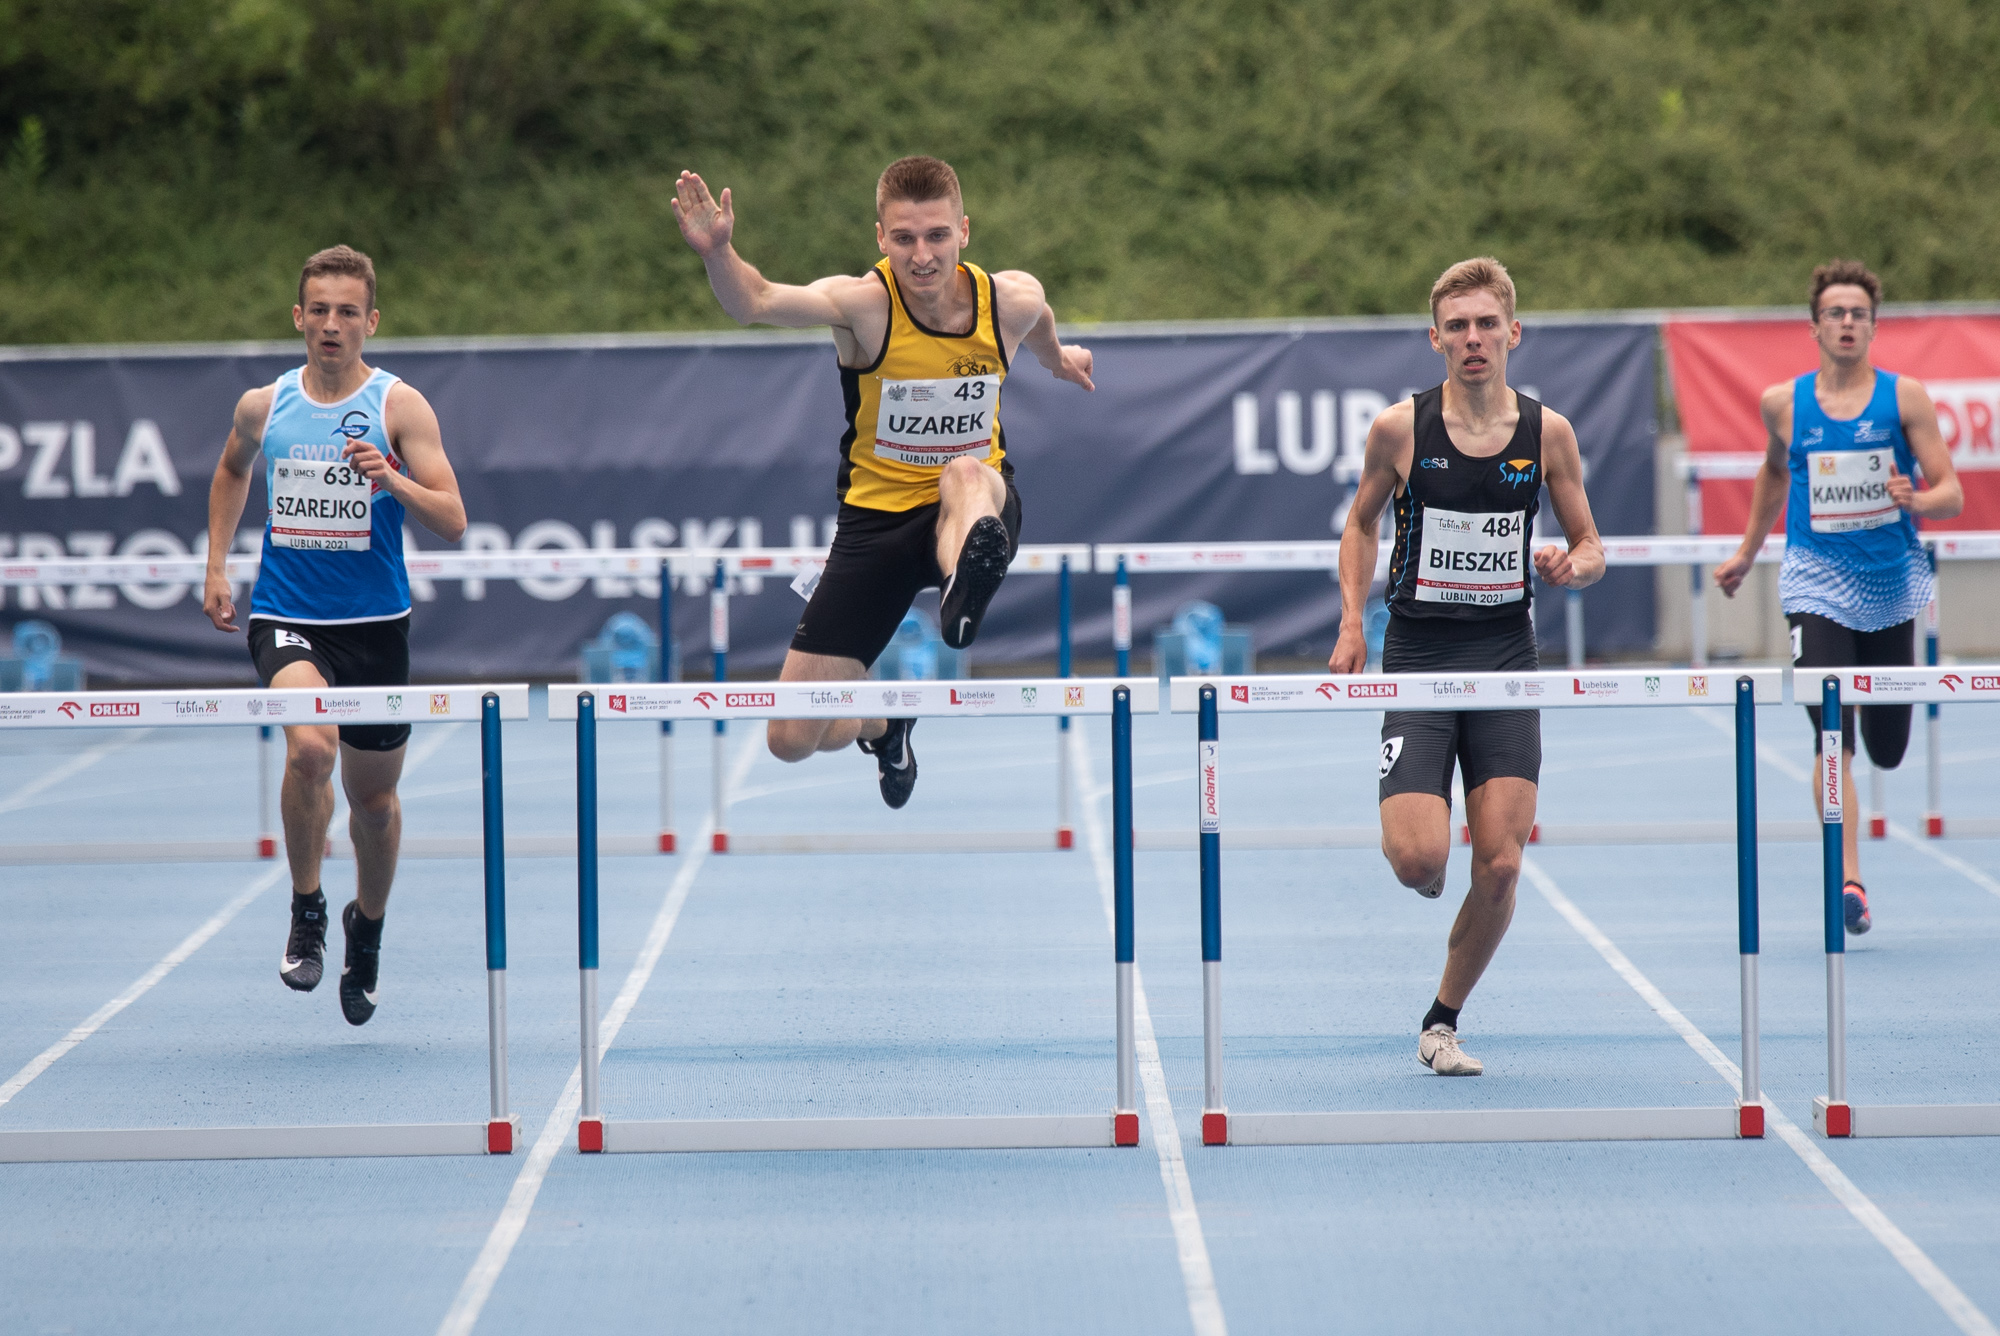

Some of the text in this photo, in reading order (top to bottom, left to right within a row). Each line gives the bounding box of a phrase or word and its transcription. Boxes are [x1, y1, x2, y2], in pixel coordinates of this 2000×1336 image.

[958, 364, 988, 377] OSA
[954, 381, 985, 401] 43
[889, 411, 986, 435] UZAREK
[901, 453, 967, 465] LUBLIN 20
[1421, 458, 1449, 469] esa
[1869, 455, 1881, 472] 3
[294, 469, 316, 478] UMCS
[324, 466, 365, 486] 631
[1499, 462, 1536, 489] Sopot
[276, 496, 367, 519] SZAREJKO
[1482, 515, 1520, 537] 484
[290, 538, 349, 549] LUBLIN 2021
[1430, 548, 1517, 572] BIESZKE
[1441, 592, 1503, 603] LUBLIN 2021
[1350, 685, 1395, 697] ORLEN
[1582, 681, 1618, 689] lubelskie
[728, 694, 772, 706] ORLEN
[960, 691, 995, 699] lubelskie
[92, 704, 137, 716] ORLEN
[325, 700, 360, 708] lubelskie
[1826, 755, 1839, 805] polanik
[1204, 765, 1217, 815] polanik
